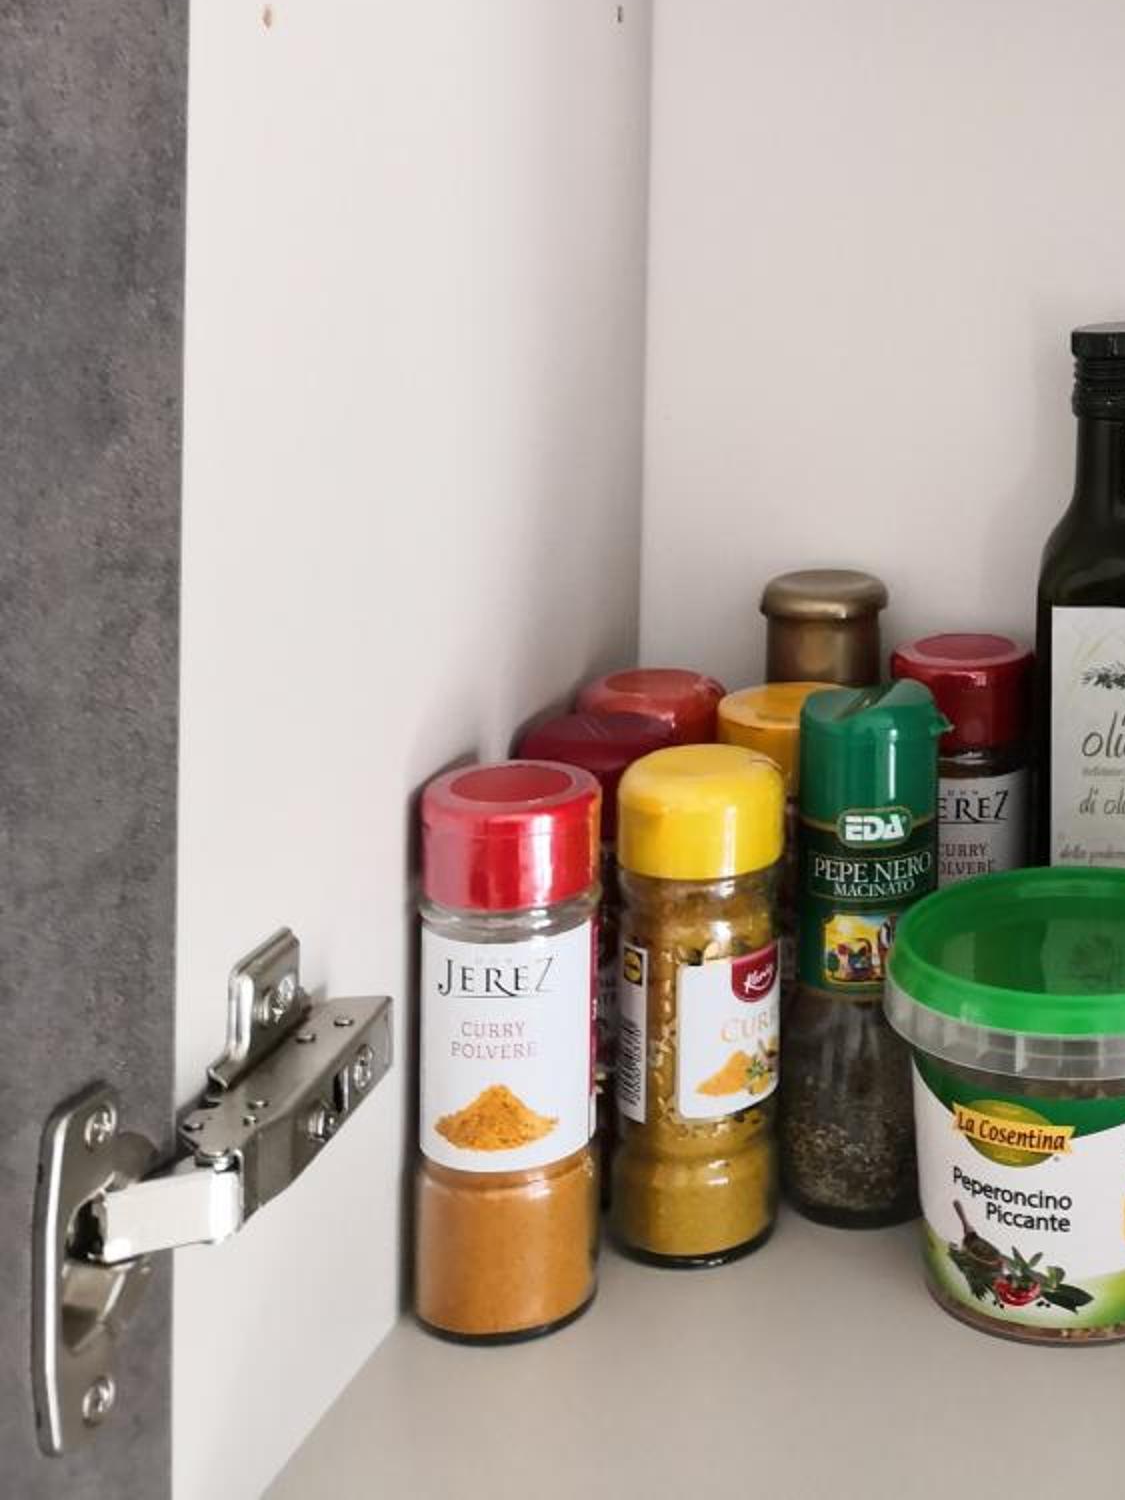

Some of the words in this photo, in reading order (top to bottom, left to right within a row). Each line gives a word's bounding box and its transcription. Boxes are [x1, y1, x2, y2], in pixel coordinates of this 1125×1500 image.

[938, 789, 1010, 822] EREZ
[844, 813, 904, 841] EDA
[814, 856, 869, 884] PEPE
[874, 851, 931, 882] NERO
[833, 878, 915, 898] MACINATO
[437, 957, 558, 997] JEREZ
[461, 1020, 527, 1039] CURRY
[450, 1040, 538, 1061] POLVERE
[956, 1111, 975, 1132] La
[979, 1119, 1066, 1151] Cosentina
[952, 1165, 1073, 1210] Peperoncino
[985, 1201, 1072, 1233] Piccante
